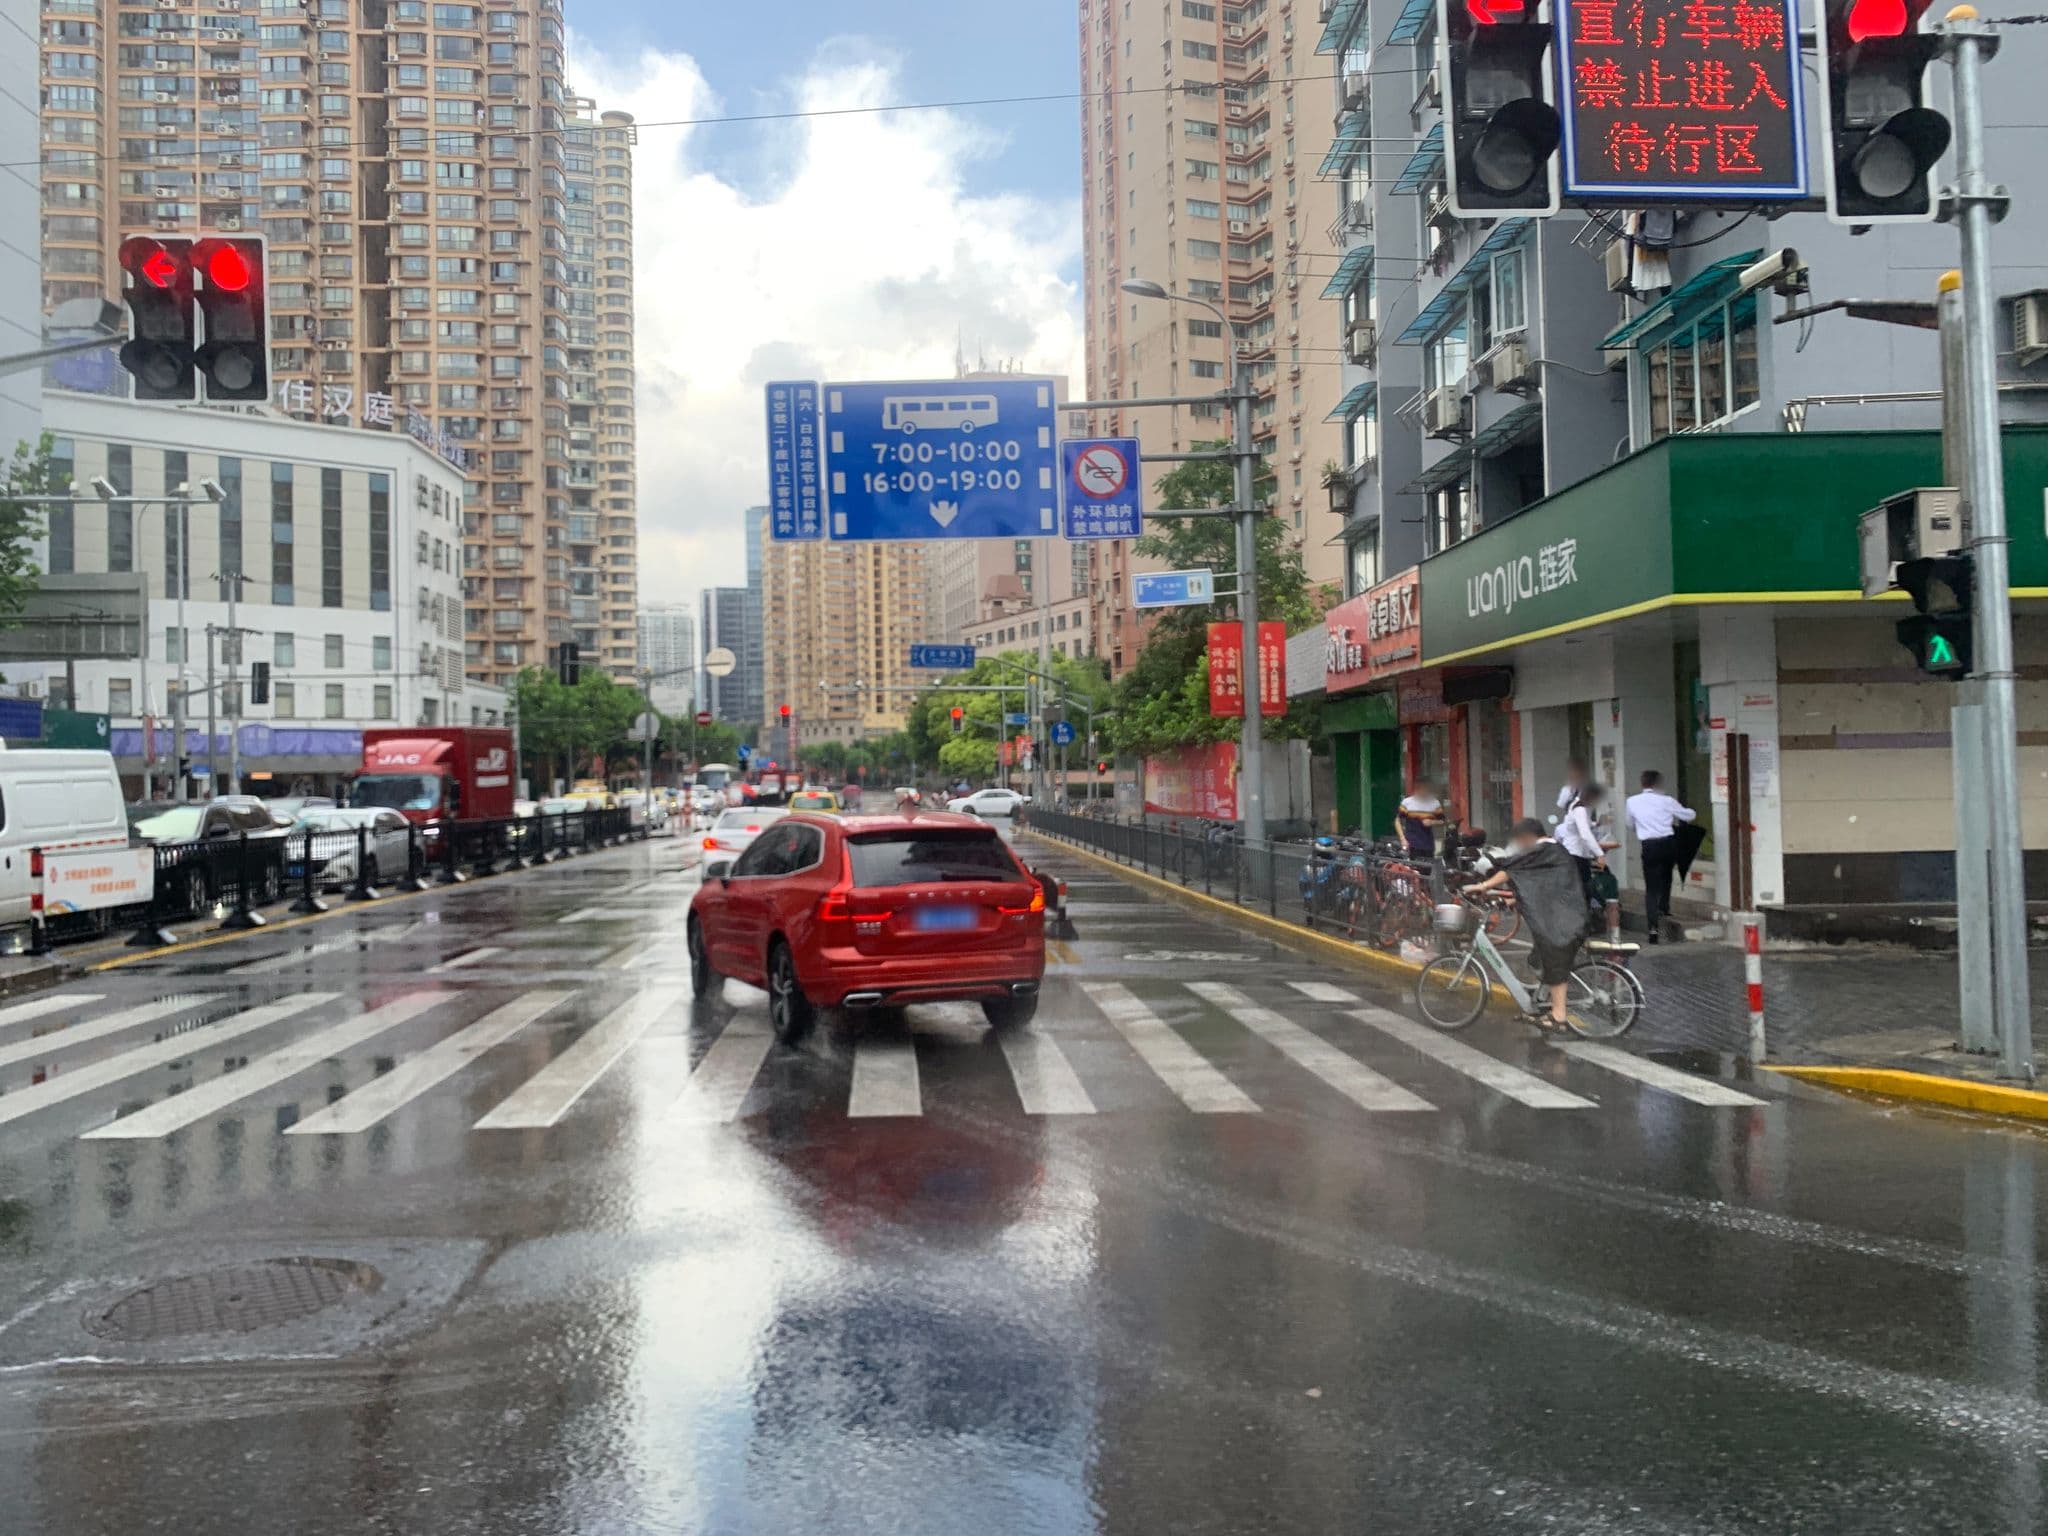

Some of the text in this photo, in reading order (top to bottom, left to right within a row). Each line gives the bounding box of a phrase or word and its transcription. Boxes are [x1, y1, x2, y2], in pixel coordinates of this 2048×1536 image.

[1571, 0, 1785, 50] 直行车辆
[1574, 56, 1788, 110] 禁止进入
[1603, 121, 1763, 173] 待行区
[871, 440, 1021, 464] 7:00-10:00
[863, 469, 1021, 494] 16:00-19:00
[1072, 504, 1133, 519] 外环线内
[1539, 537, 1578, 593] 链家
[377, 753, 421, 766] JAC
